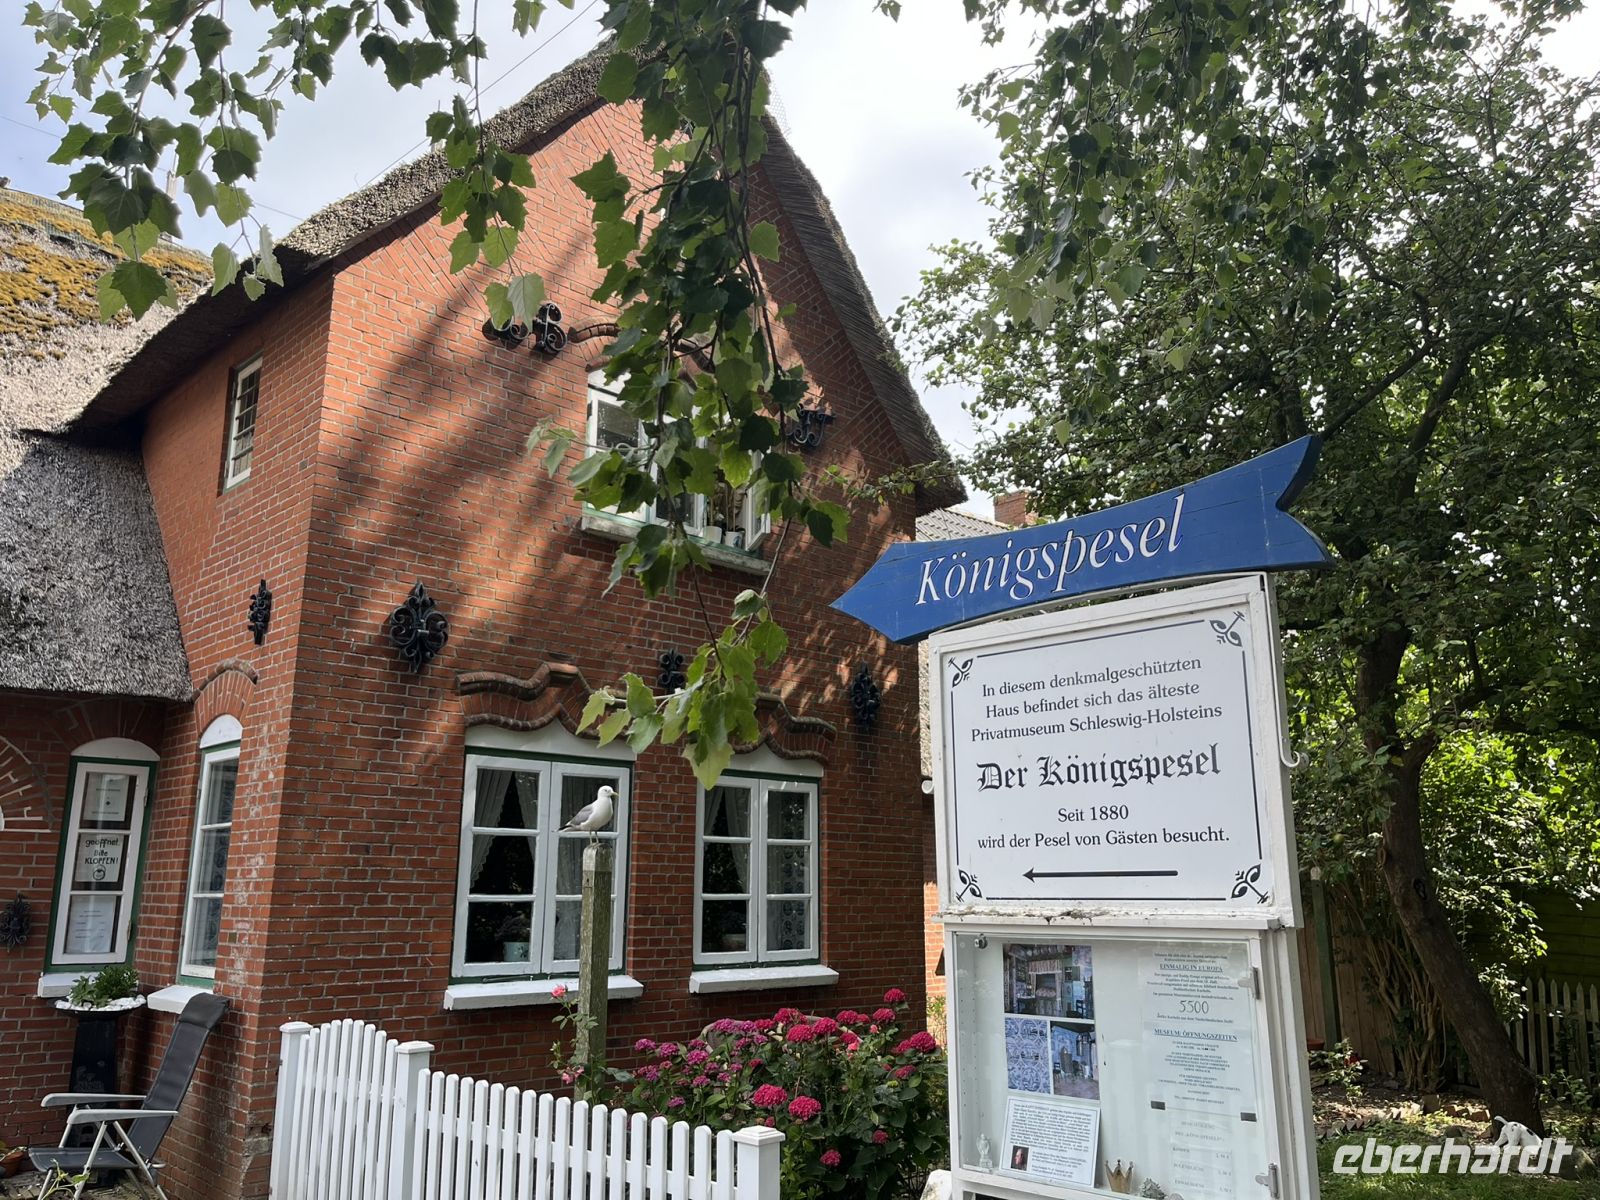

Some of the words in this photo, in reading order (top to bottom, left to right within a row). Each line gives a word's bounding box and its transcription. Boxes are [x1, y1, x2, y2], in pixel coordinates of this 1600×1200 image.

[915, 493, 1185, 605] Königspesel
[982, 684, 995, 697] In
[999, 679, 1046, 695] diesem
[1050, 658, 1202, 689] denkmalgeschützten
[986, 704, 1020, 718] Haus
[1023, 696, 1079, 714] befindet
[1083, 691, 1112, 708] sich
[1117, 688, 1143, 702] das
[1148, 681, 1200, 699] älteste
[971, 721, 1065, 742] Privatmuseum
[1069, 705, 1223, 732] Schleswig-Holsteins
[976, 762, 1029, 792] Der
[1036, 743, 1222, 788] Königspesel
[1057, 808, 1085, 822] Seit
[1090, 805, 1129, 821] 1880
[977, 834, 1005, 849] wird
[1009, 834, 1031, 847] der
[1035, 832, 1071, 847] Pesel
[1075, 834, 1101, 846] von
[1105, 830, 1158, 845] Gästen
[1162, 826, 1230, 843] besucht.
[1179, 1000, 1209, 1014] 5500
